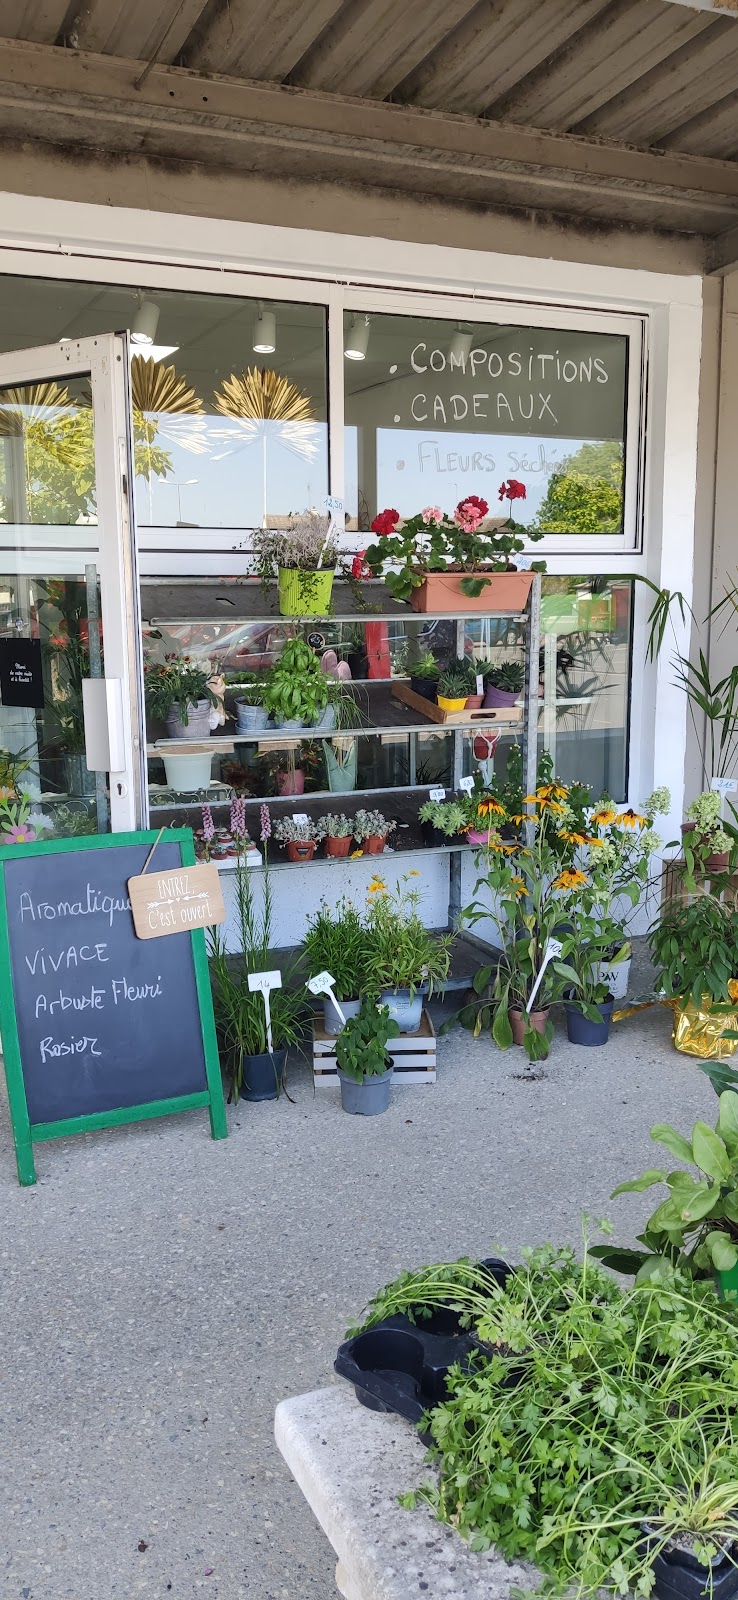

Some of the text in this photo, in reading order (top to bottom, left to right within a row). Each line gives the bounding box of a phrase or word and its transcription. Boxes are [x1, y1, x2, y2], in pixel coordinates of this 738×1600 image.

[410, 392, 558, 424] CADEAUX
[417, 440, 497, 473] FLEURS
[148, 899, 213, 930] C'est ouvert
[111, 975, 163, 1005] Fleuri
[256, 980, 270, 989] 14
[39, 1035, 102, 1064] Rosier
